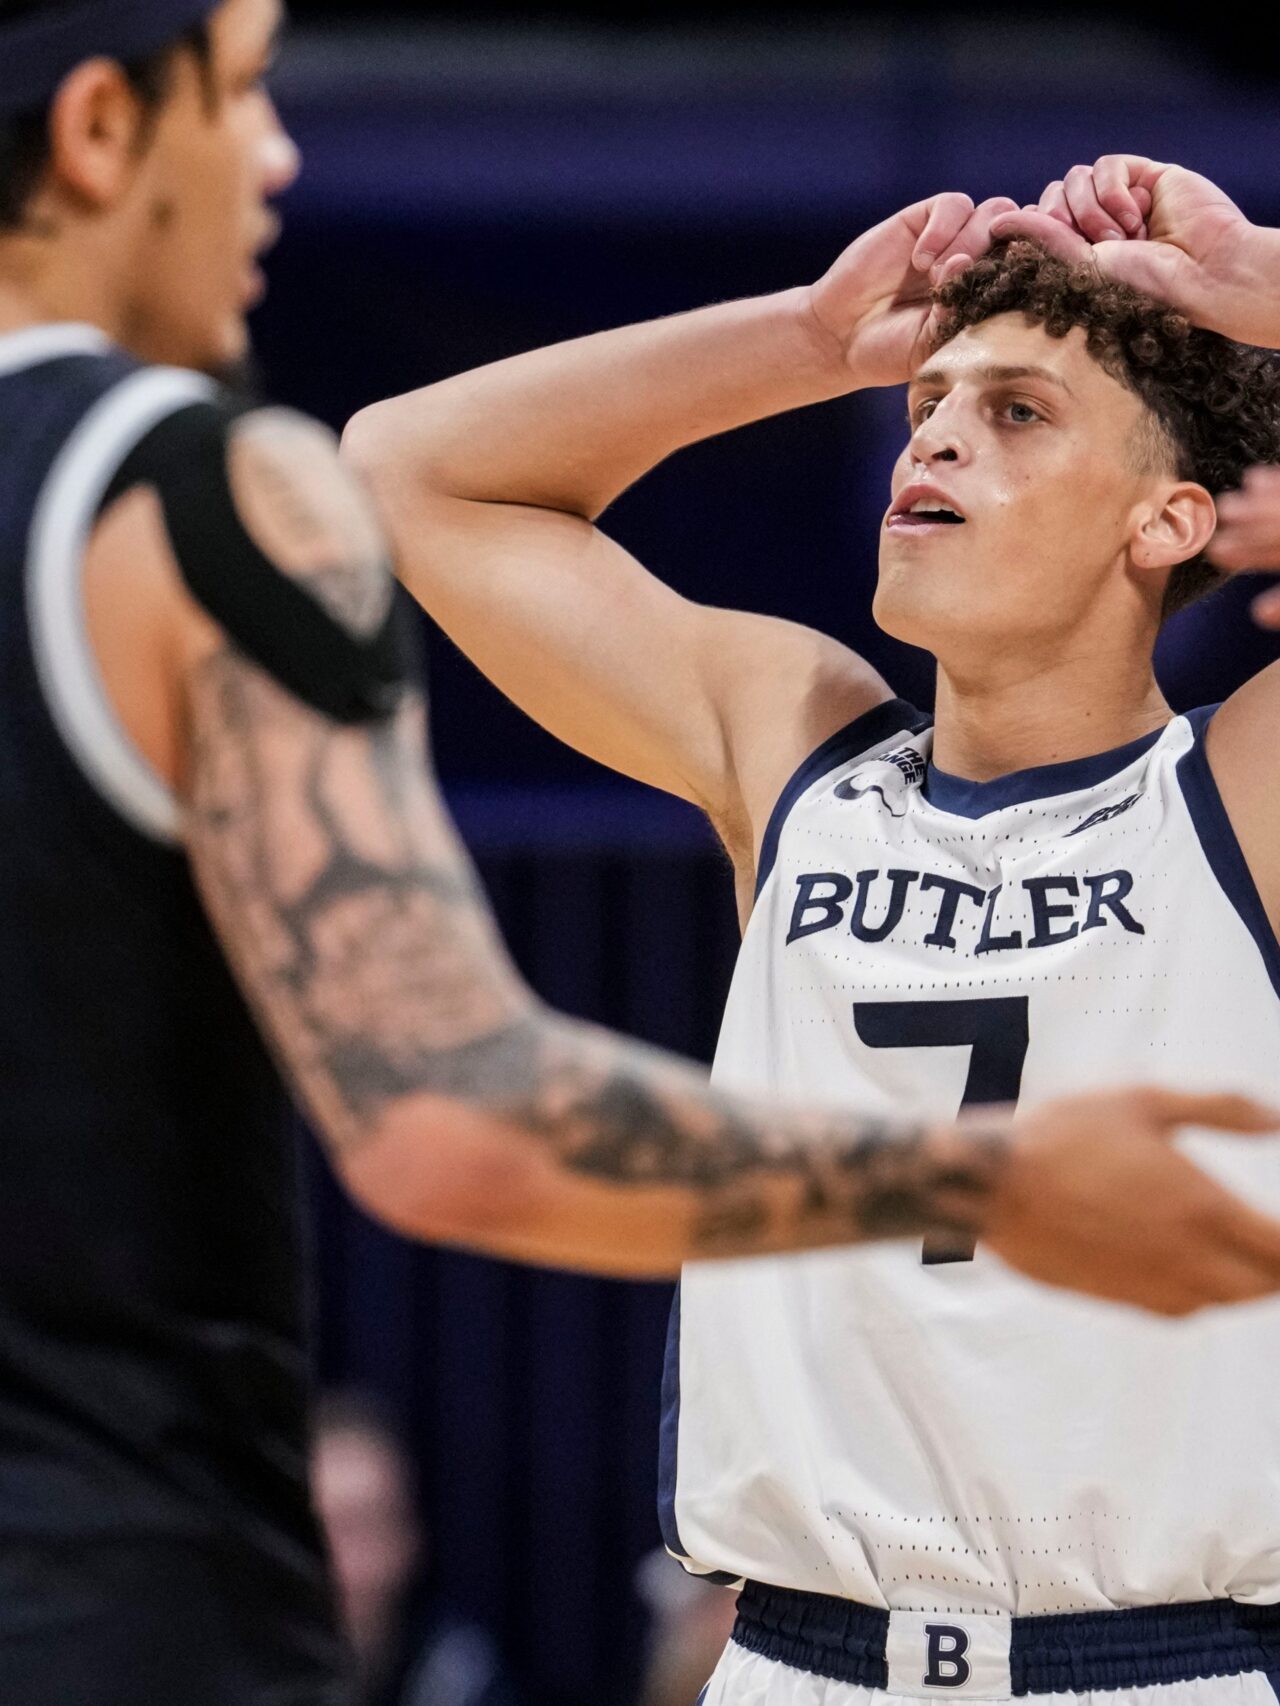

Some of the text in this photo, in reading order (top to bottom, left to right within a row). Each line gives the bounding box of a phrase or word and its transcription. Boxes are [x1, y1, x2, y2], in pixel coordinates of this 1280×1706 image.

[897, 747, 925, 777] THE
[786, 868, 1146, 956] BUTLER
[853, 995, 1030, 1265] 7
[922, 1622, 972, 1689] B
